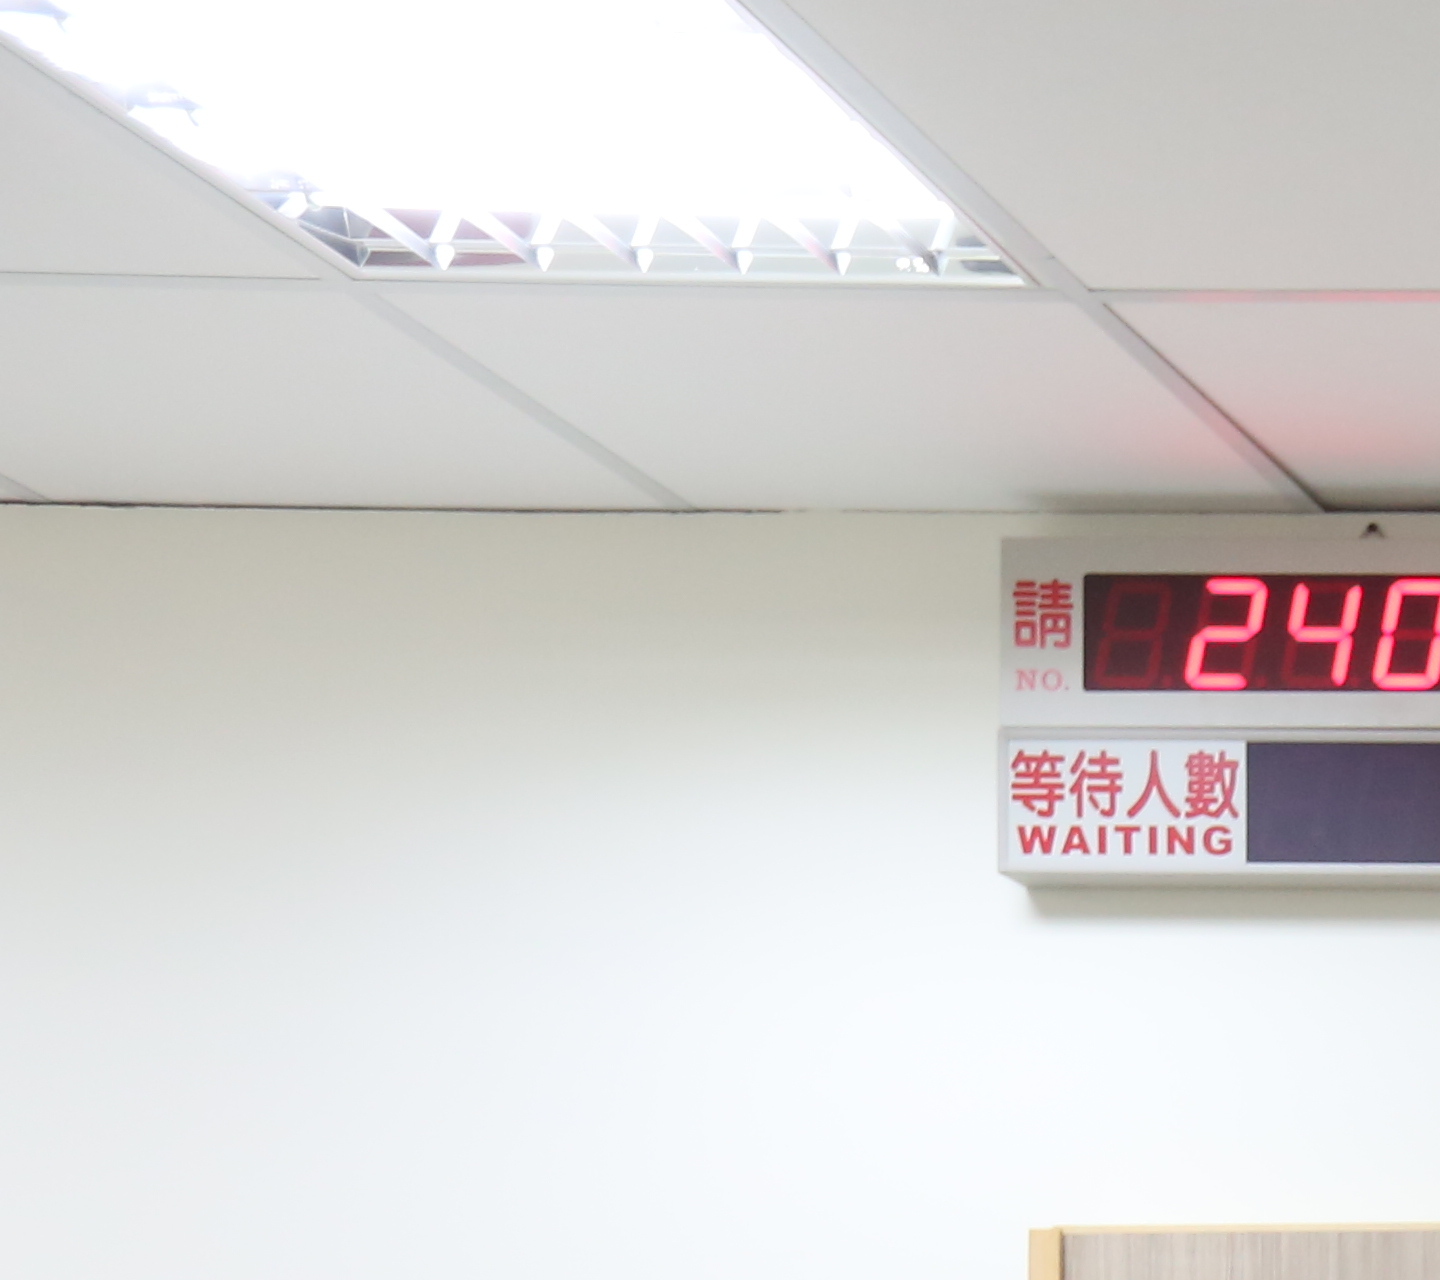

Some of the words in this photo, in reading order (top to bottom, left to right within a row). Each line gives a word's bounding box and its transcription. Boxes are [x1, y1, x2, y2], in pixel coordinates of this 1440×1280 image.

[1013, 579, 1072, 650] 請
[1014, 669, 1070, 692] NO.
[1010, 749, 1240, 820] 等待人數
[1016, 824, 1236, 857] WAITING
